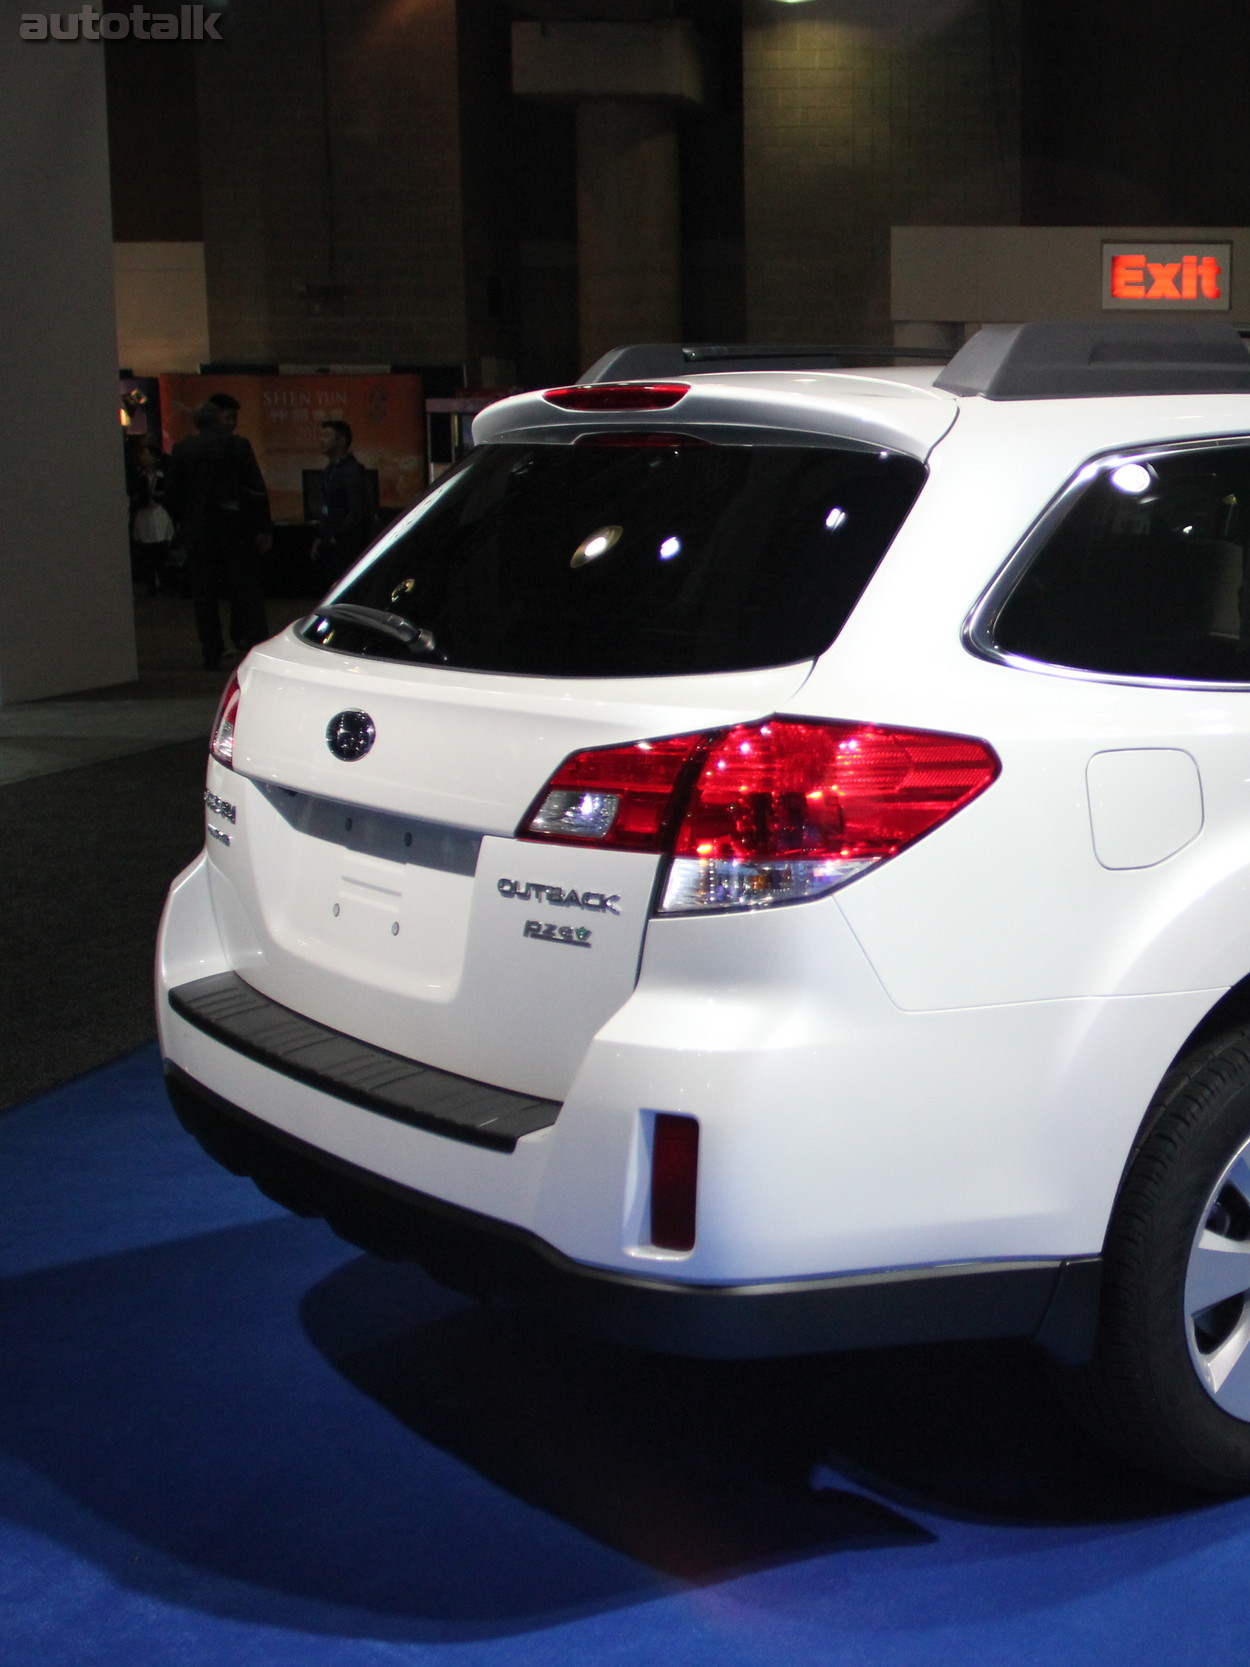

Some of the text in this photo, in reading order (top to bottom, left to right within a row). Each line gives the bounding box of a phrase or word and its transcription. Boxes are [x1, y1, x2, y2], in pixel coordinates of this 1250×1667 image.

[1111, 254, 1221, 299] Exit
[263, 391, 348, 406] SHEN YUN
[497, 878, 622, 916] OUTBACK
